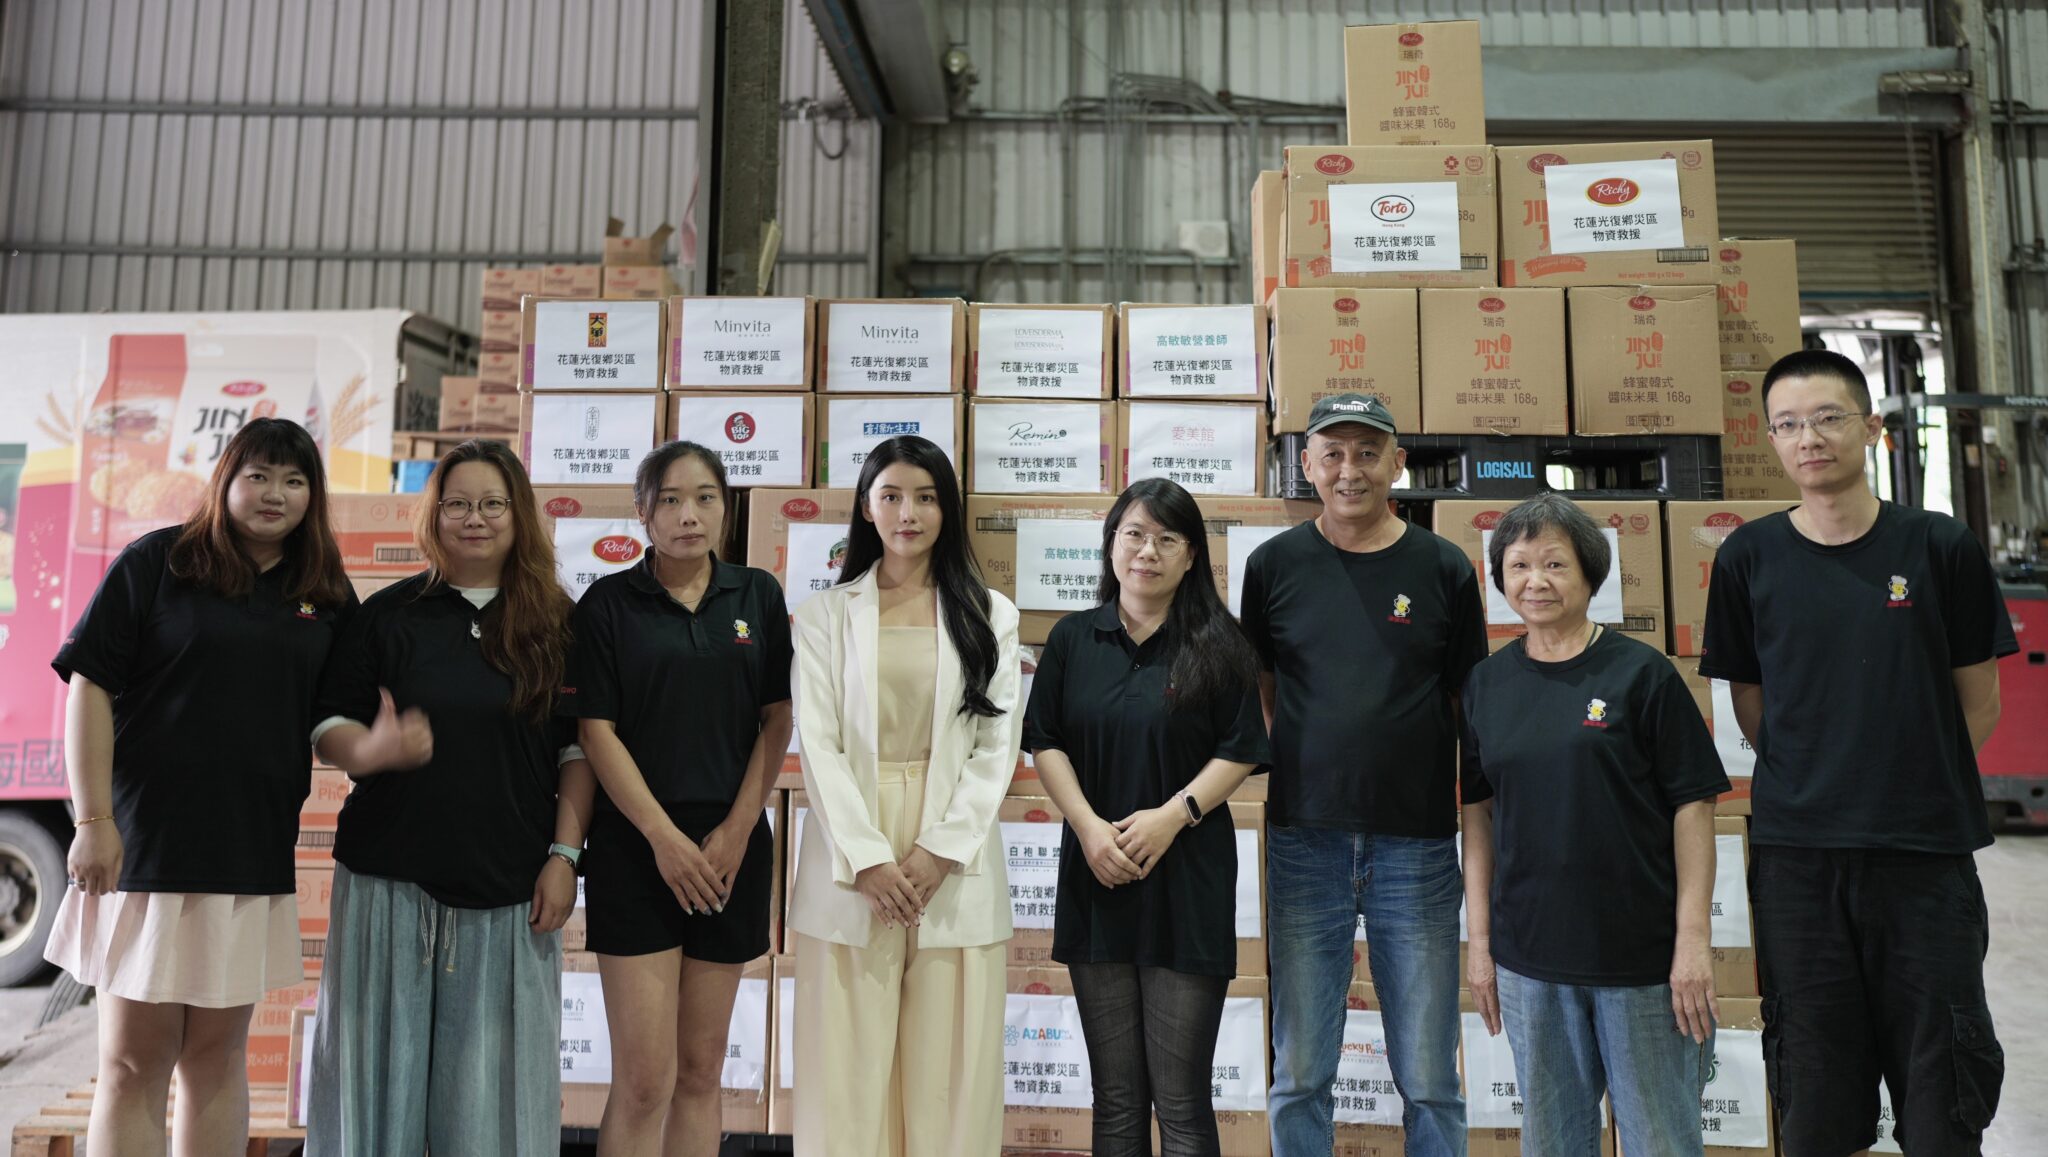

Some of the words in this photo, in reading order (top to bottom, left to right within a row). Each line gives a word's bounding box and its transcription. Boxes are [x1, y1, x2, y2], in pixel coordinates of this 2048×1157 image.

[1396, 70, 1418, 86] JIN
[1404, 85, 1424, 100] JU
[1433, 118, 1455, 130] 168g
[1322, 156, 1346, 173] Richy
[1598, 179, 1631, 202] Richy
[1378, 200, 1408, 216] Torto
[1573, 213, 1658, 229] 花蓮光復鄉災區
[1592, 228, 1641, 242] 物資救援
[1354, 236, 1436, 248] 花蓮光復鄉災區
[1372, 250, 1419, 262] 物資救援
[714, 320, 771, 333] Minvita
[1337, 317, 1360, 328] 瑞奇
[1482, 317, 1505, 328] 瑞奇
[1634, 314, 1656, 326] 瑞奇
[861, 326, 919, 339] Minvita
[1752, 332, 1774, 344] 168g
[1156, 335, 1228, 346] 高敏敏營養師
[1330, 339, 1354, 355] JIN
[1474, 339, 1498, 355] JIN
[1626, 336, 1650, 354] JIN
[557, 353, 636, 366] 花蓮光復鄉災區
[703, 350, 782, 363] 花蓮光復鄉災區
[850, 356, 928, 368] 花蓮光復鄉災區
[1636, 353, 1656, 370] JU
[720, 364, 764, 376] 物資救援
[1001, 362, 1078, 374] 花蓮光復鄉災區
[1153, 360, 1232, 372] 花蓮光復鄉災區
[1338, 355, 1358, 372] JU
[1484, 355, 1504, 372] JU
[574, 368, 618, 379] 物資救援
[867, 370, 912, 382] 物資救援
[1170, 374, 1216, 386] 物資救援
[1017, 375, 1062, 387] 物資救援
[1326, 378, 1374, 390] 蜂蜜韓式
[1470, 378, 1521, 390] 蜂蜜韓式
[1623, 376, 1674, 389] 蜂蜜韓式
[1513, 392, 1538, 406] 168g
[1666, 392, 1692, 404] 168g
[193, 408, 248, 434] JIN
[731, 426, 750, 434] BIG
[1172, 426, 1215, 442] 愛美館
[553, 448, 630, 460] 花蓮光復鄉災區
[568, 462, 613, 474] 物資救援
[998, 457, 1078, 468] 花蓮光復鄉災區
[1152, 456, 1232, 470] 花蓮光復鄉災區
[1016, 471, 1060, 482] 物資救援
[1476, 462, 1534, 479] LOGISALL
[1761, 468, 1784, 478] 168g
[1169, 472, 1214, 484] 物資救援
[550, 501, 575, 515] Richy
[786, 502, 812, 517] Richy
[602, 538, 635, 561] Richy
[1014, 1080, 1062, 1094] 物資救援
